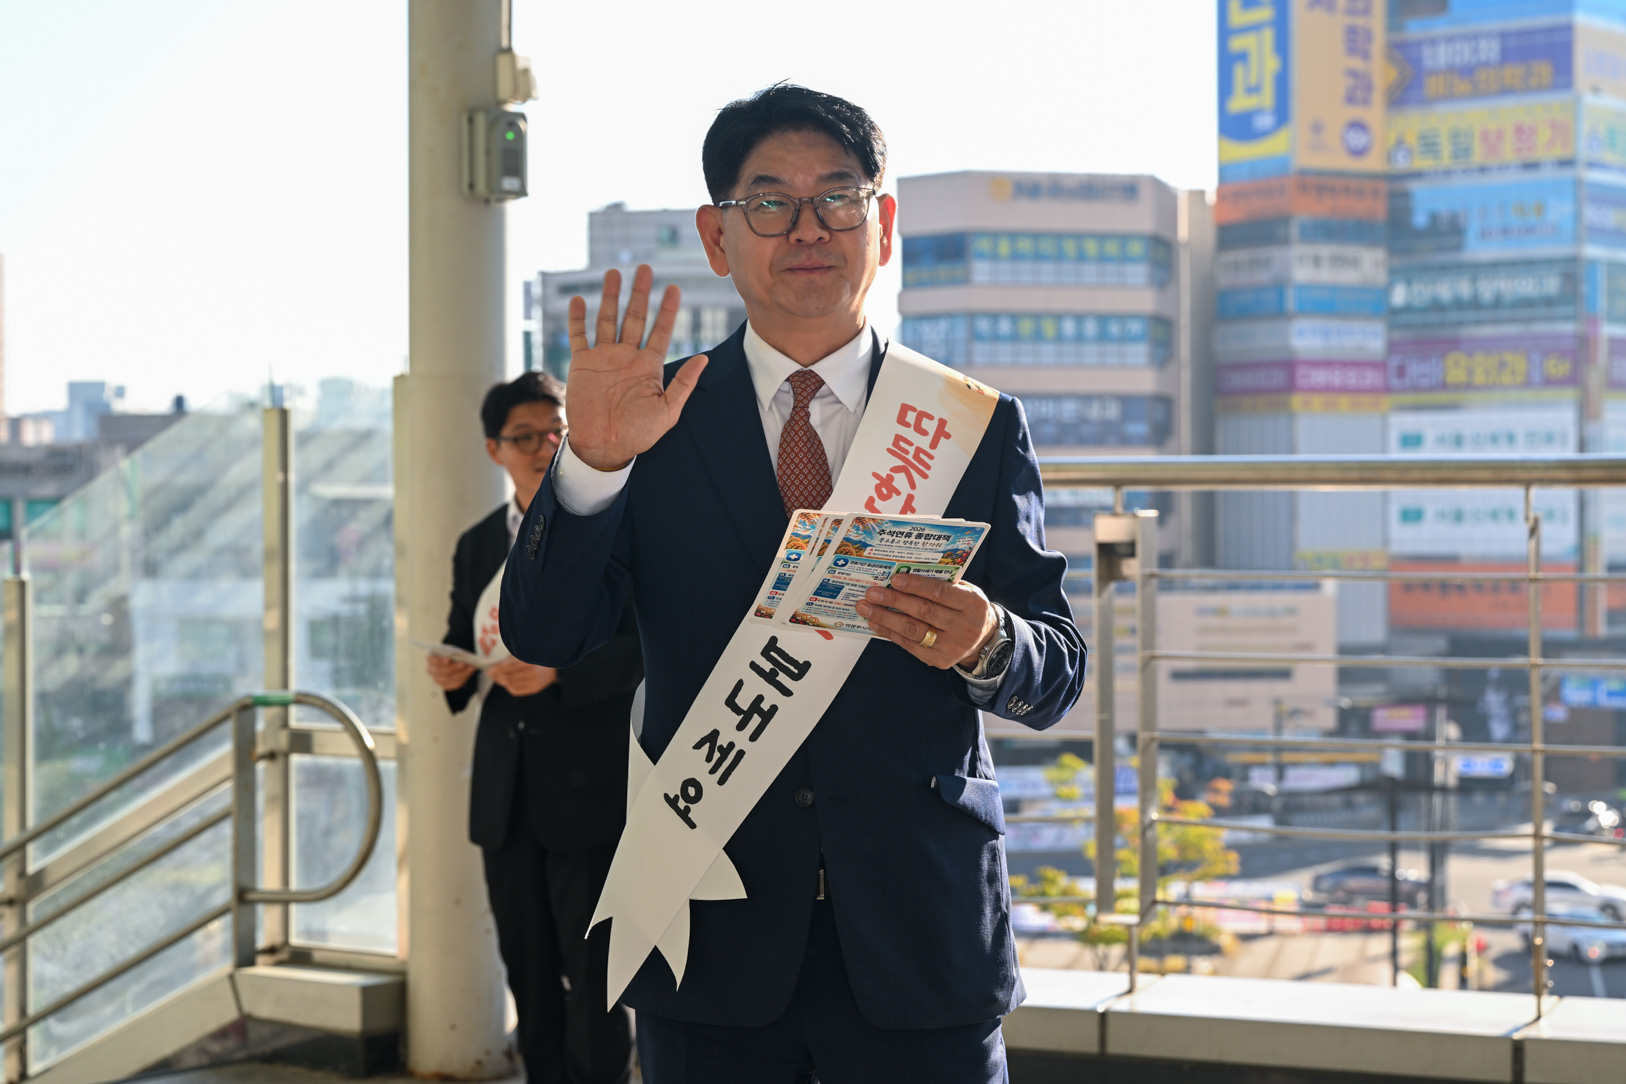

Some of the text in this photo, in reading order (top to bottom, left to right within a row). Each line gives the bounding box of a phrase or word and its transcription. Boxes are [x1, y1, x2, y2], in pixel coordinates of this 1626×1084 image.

[864, 402, 952, 514] 따뜻한
[877, 528, 914, 540] 추석연휴
[914, 532, 952, 541] 종합대책
[663, 635, 811, 830] 보내세요
